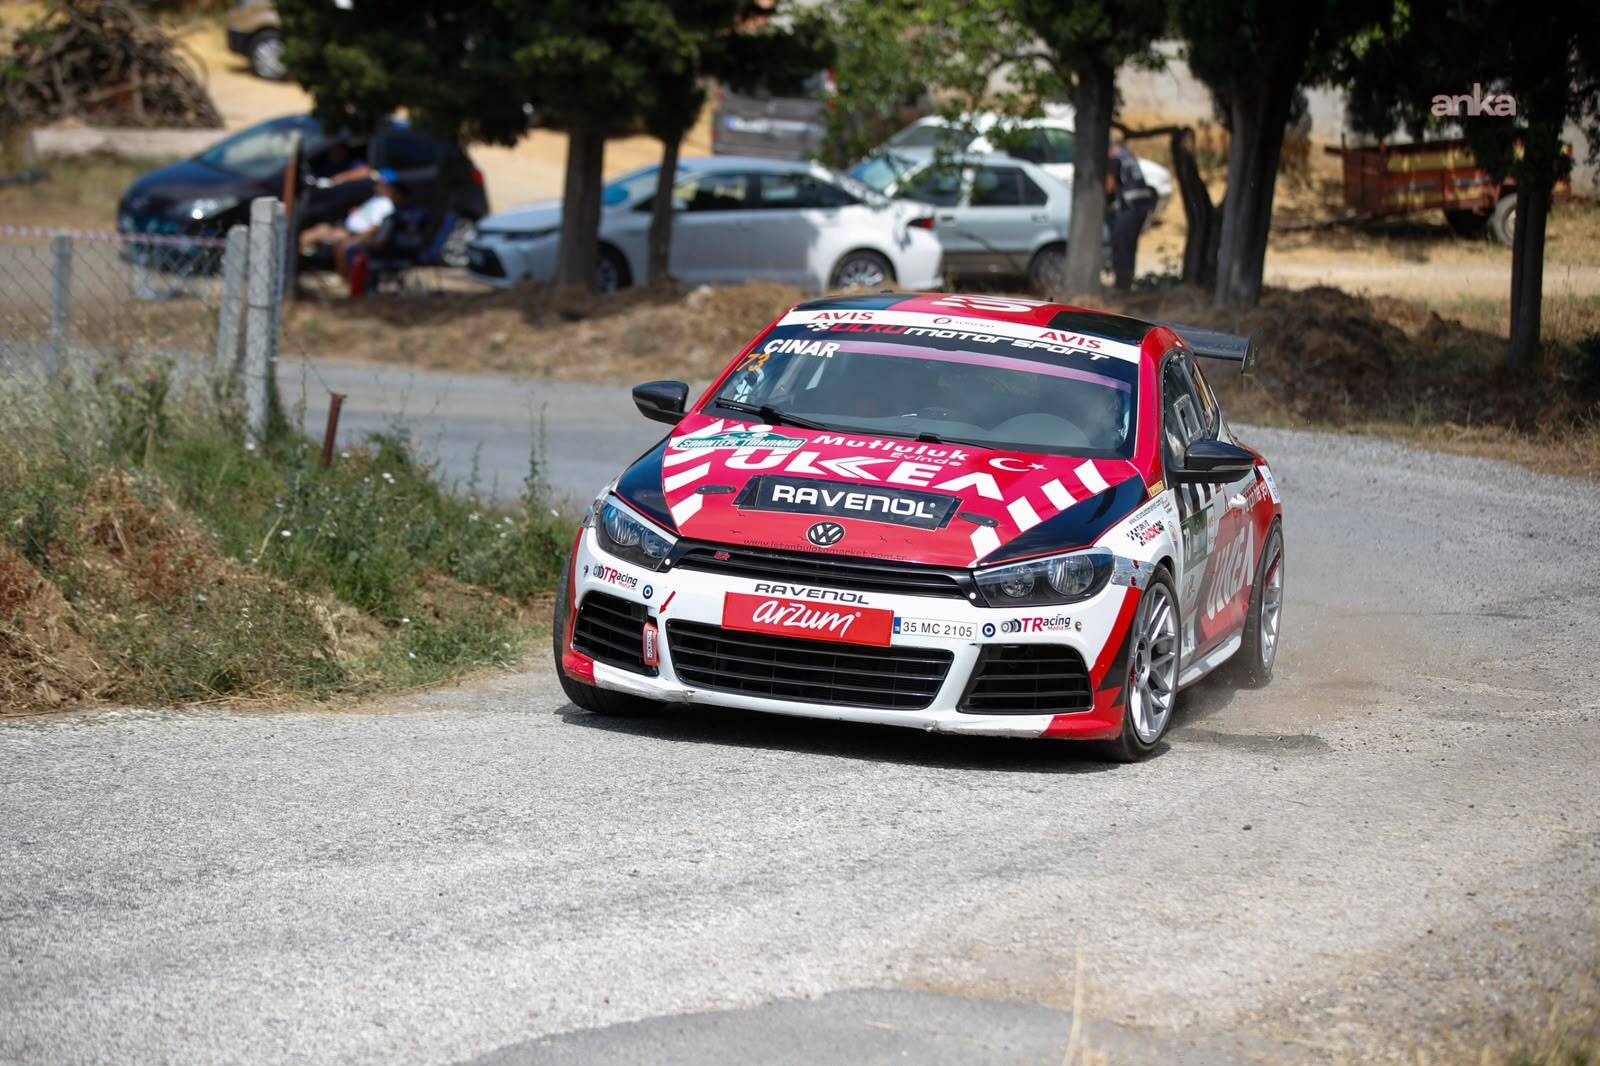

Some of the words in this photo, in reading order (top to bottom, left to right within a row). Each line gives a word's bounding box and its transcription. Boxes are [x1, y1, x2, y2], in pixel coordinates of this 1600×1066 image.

[813, 311, 875, 321] AVIS
[1039, 330, 1103, 350] AVIS
[812, 435, 970, 461] Mutluluk
[771, 484, 934, 519] RAVENOL
[754, 583, 870, 605] RAVENOL
[752, 600, 856, 638] arzum
[902, 621, 917, 633] 35
[921, 623, 941, 635] MC
[943, 624, 973, 638] 2105
